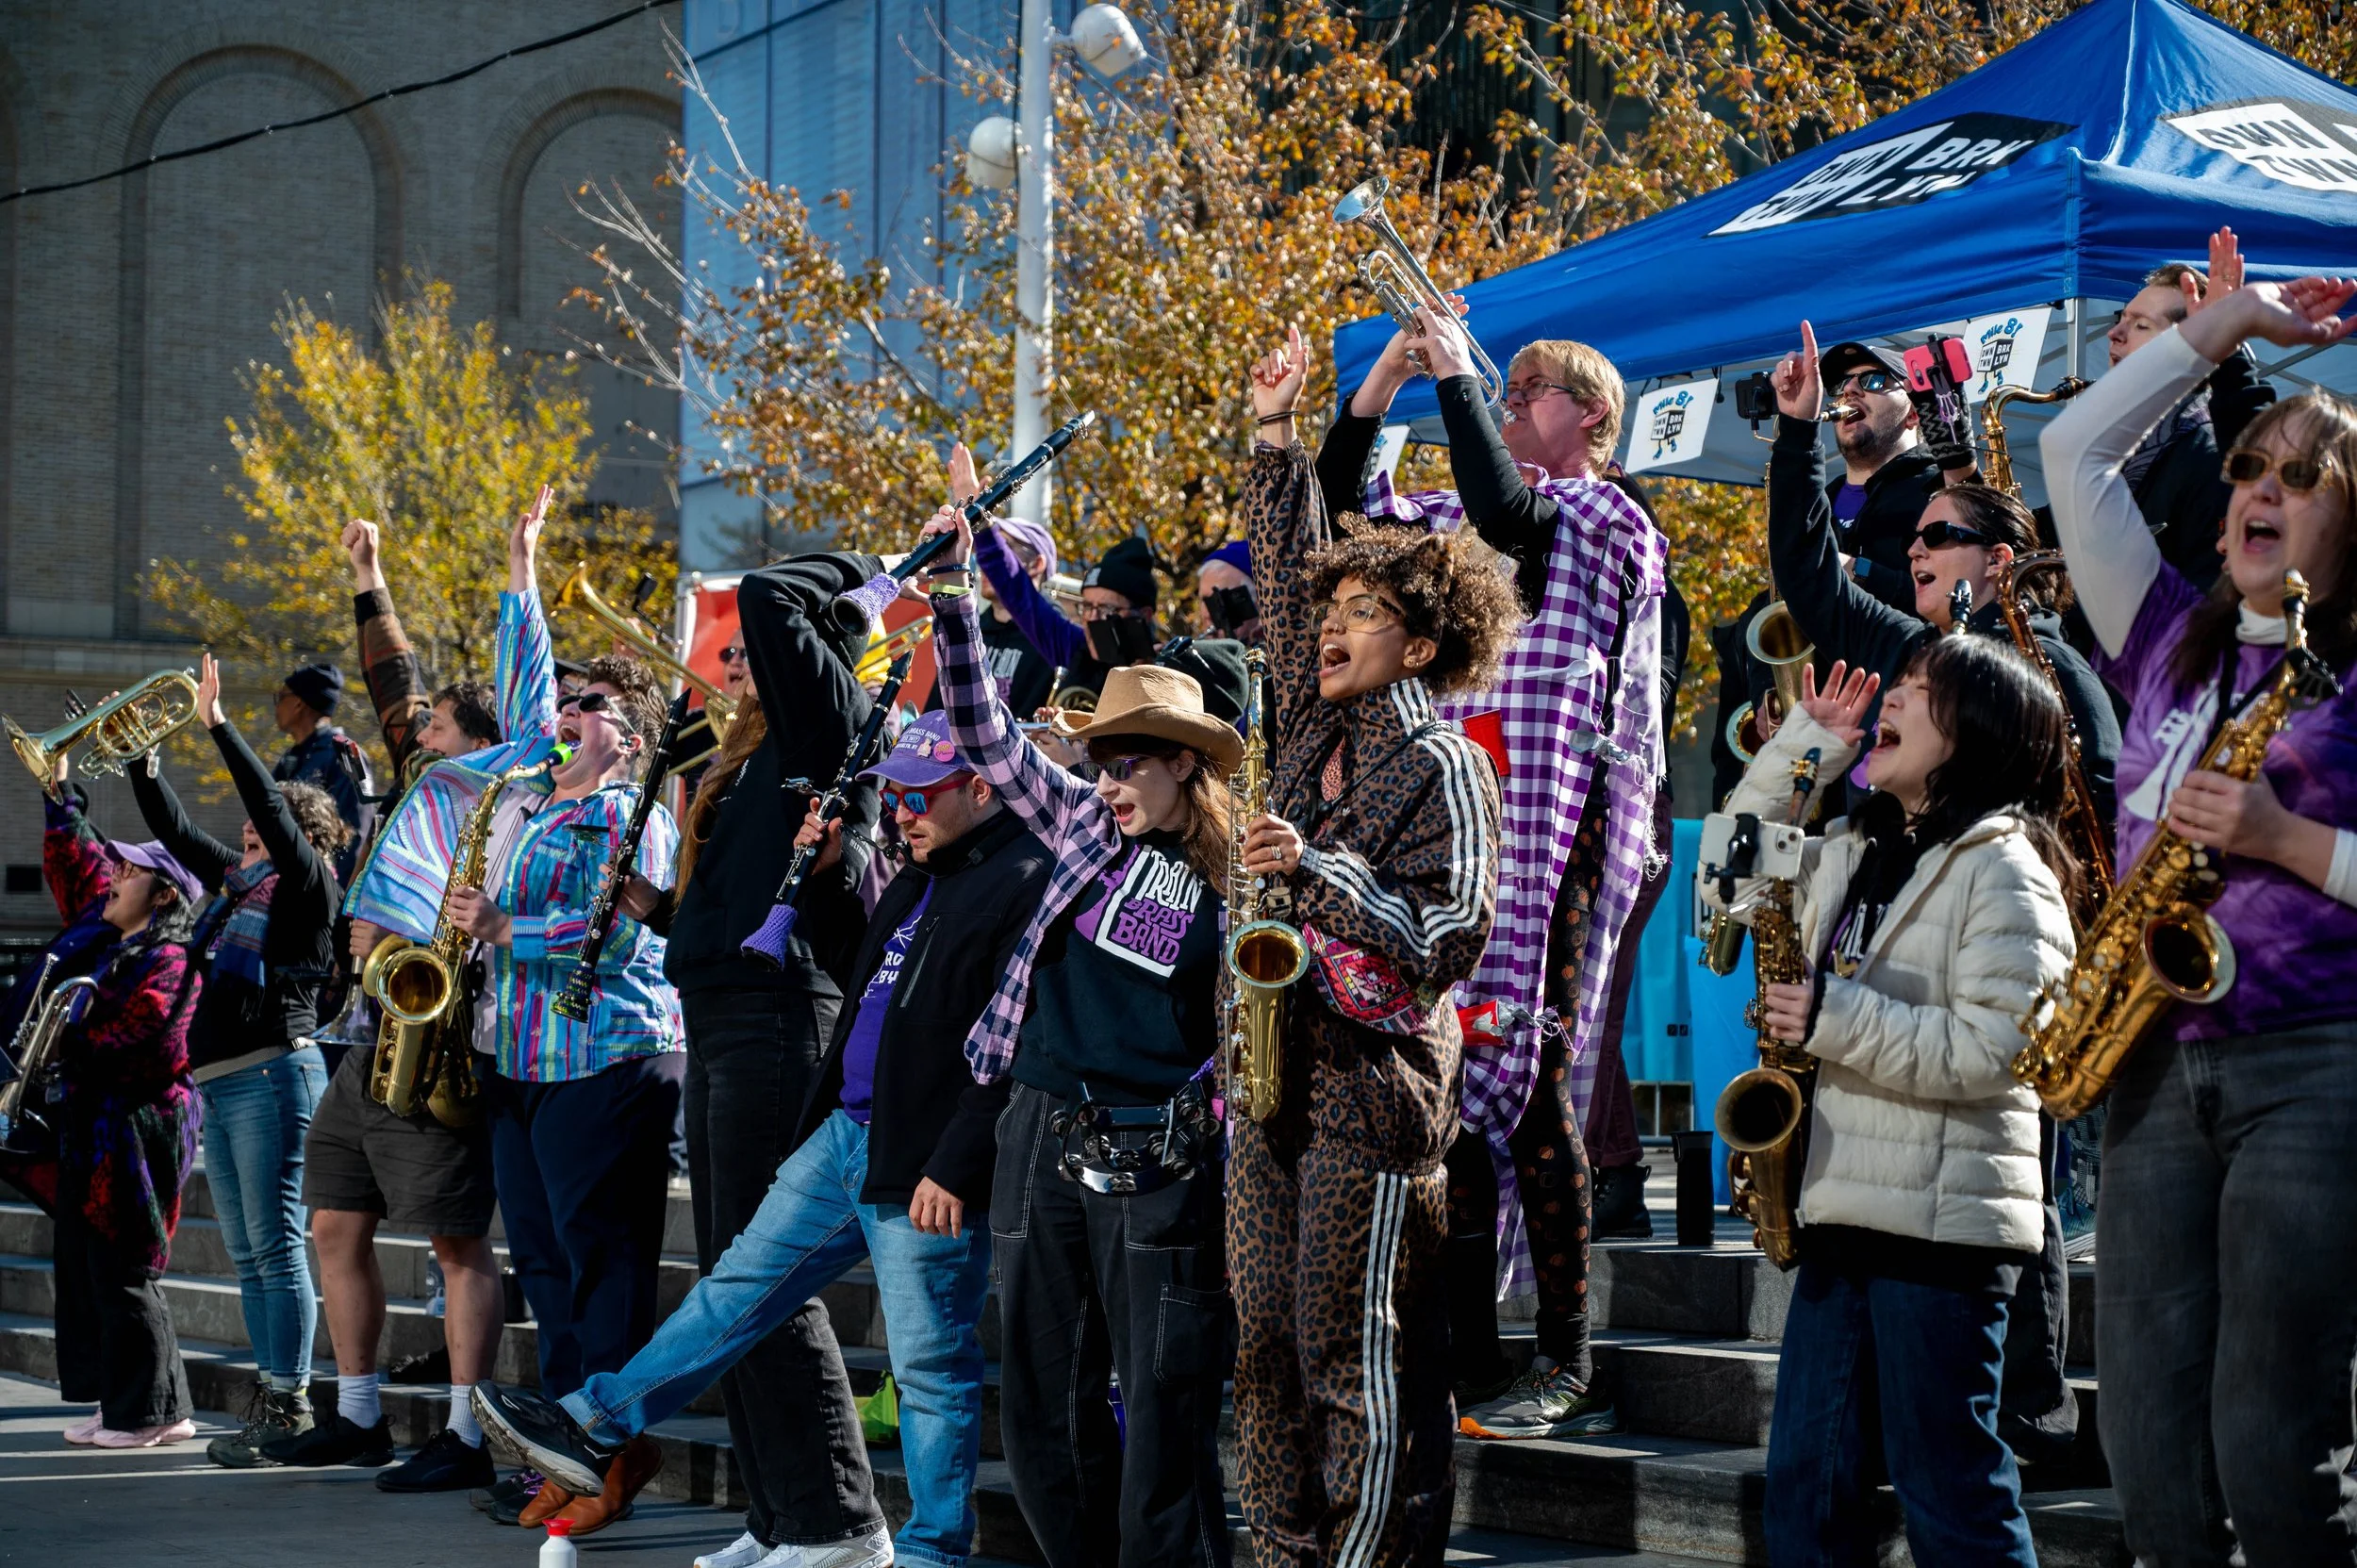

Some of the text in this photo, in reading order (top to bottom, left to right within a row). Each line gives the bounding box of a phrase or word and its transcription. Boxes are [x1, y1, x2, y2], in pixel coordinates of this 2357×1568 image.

[1904, 138, 2036, 170] BRK
[1836, 171, 1977, 206] LYN
[2003, 318, 2023, 338] 8!
[1996, 344, 2011, 355] BRK
[1993, 354, 2009, 366] LYN
[1667, 423, 1682, 434] LYN
[1669, 414, 1683, 424] BRK
[924, 730, 941, 742] BAND
[1134, 850, 1207, 914] TRAIN
[1124, 898, 1195, 940] BRASS
[1111, 911, 1180, 965] BAND
